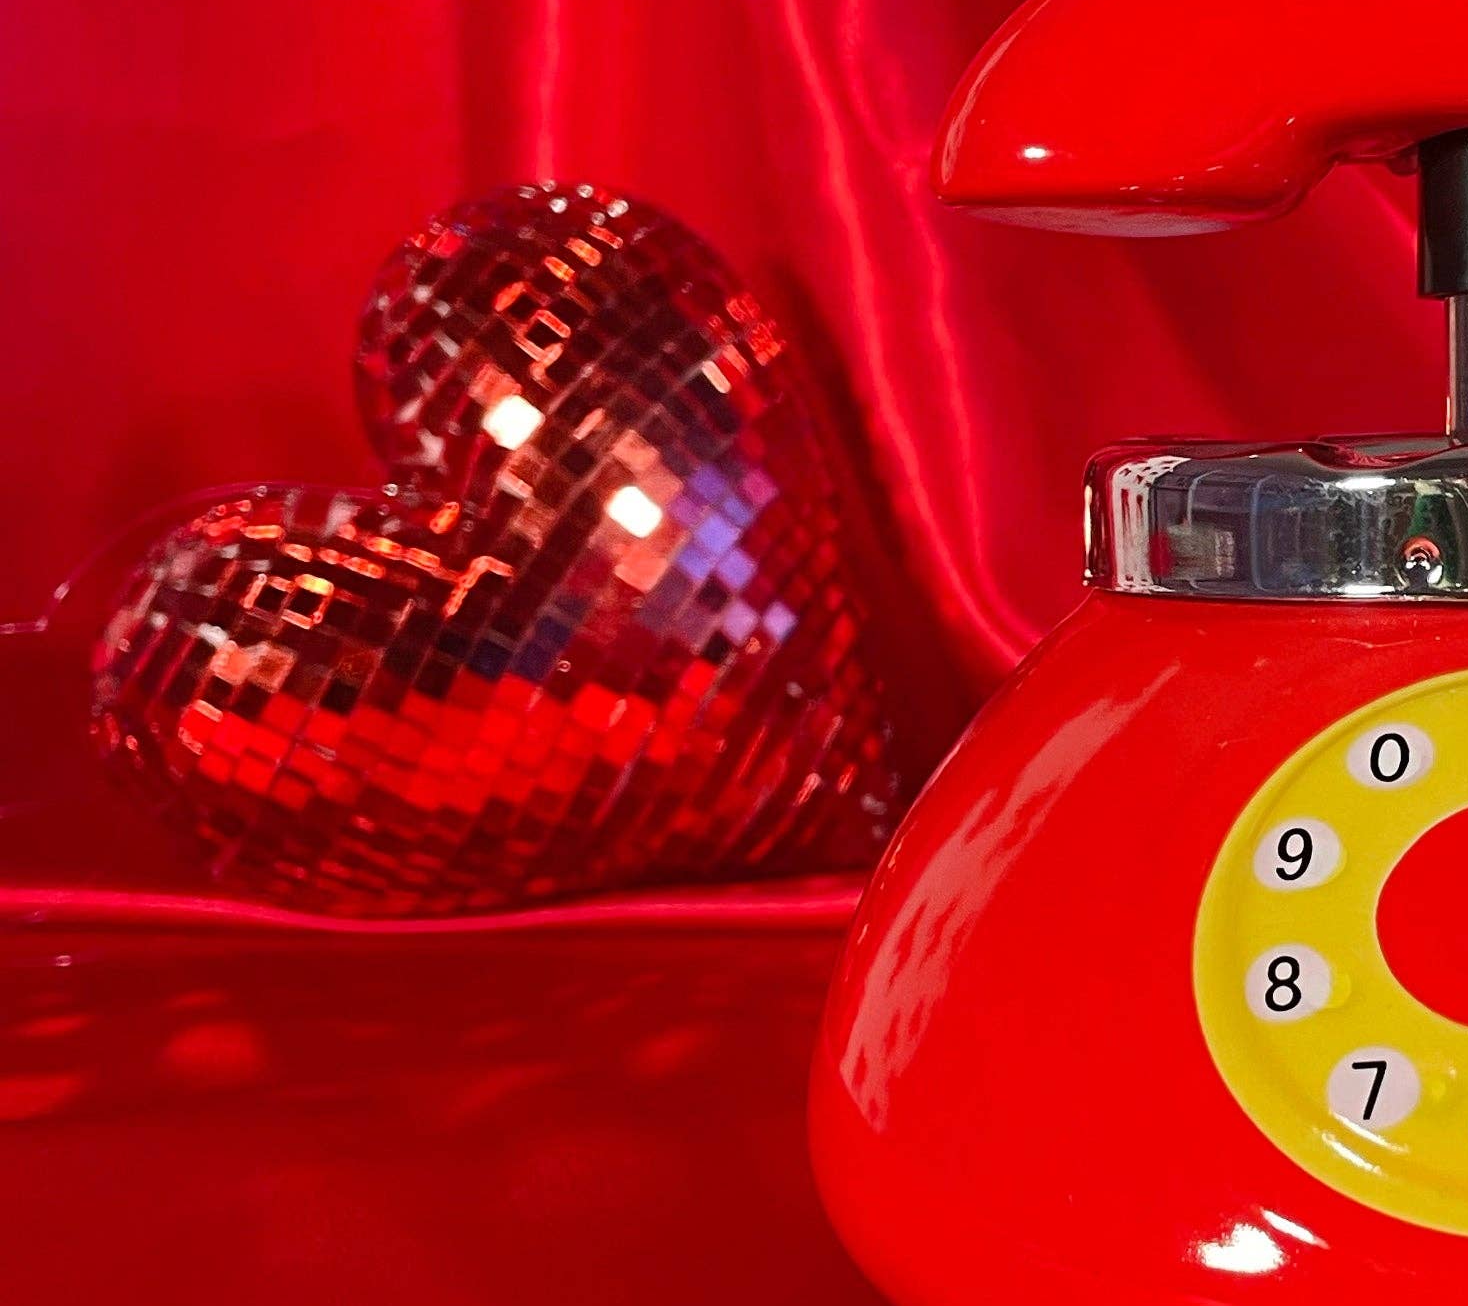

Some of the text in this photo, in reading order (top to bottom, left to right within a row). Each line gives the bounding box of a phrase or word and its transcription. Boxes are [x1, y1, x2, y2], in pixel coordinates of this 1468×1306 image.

[1368, 732, 1411, 783] 0
[1274, 827, 1314, 882] 9
[1263, 955, 1303, 1013] 8
[1350, 1059, 1389, 1122] 7
